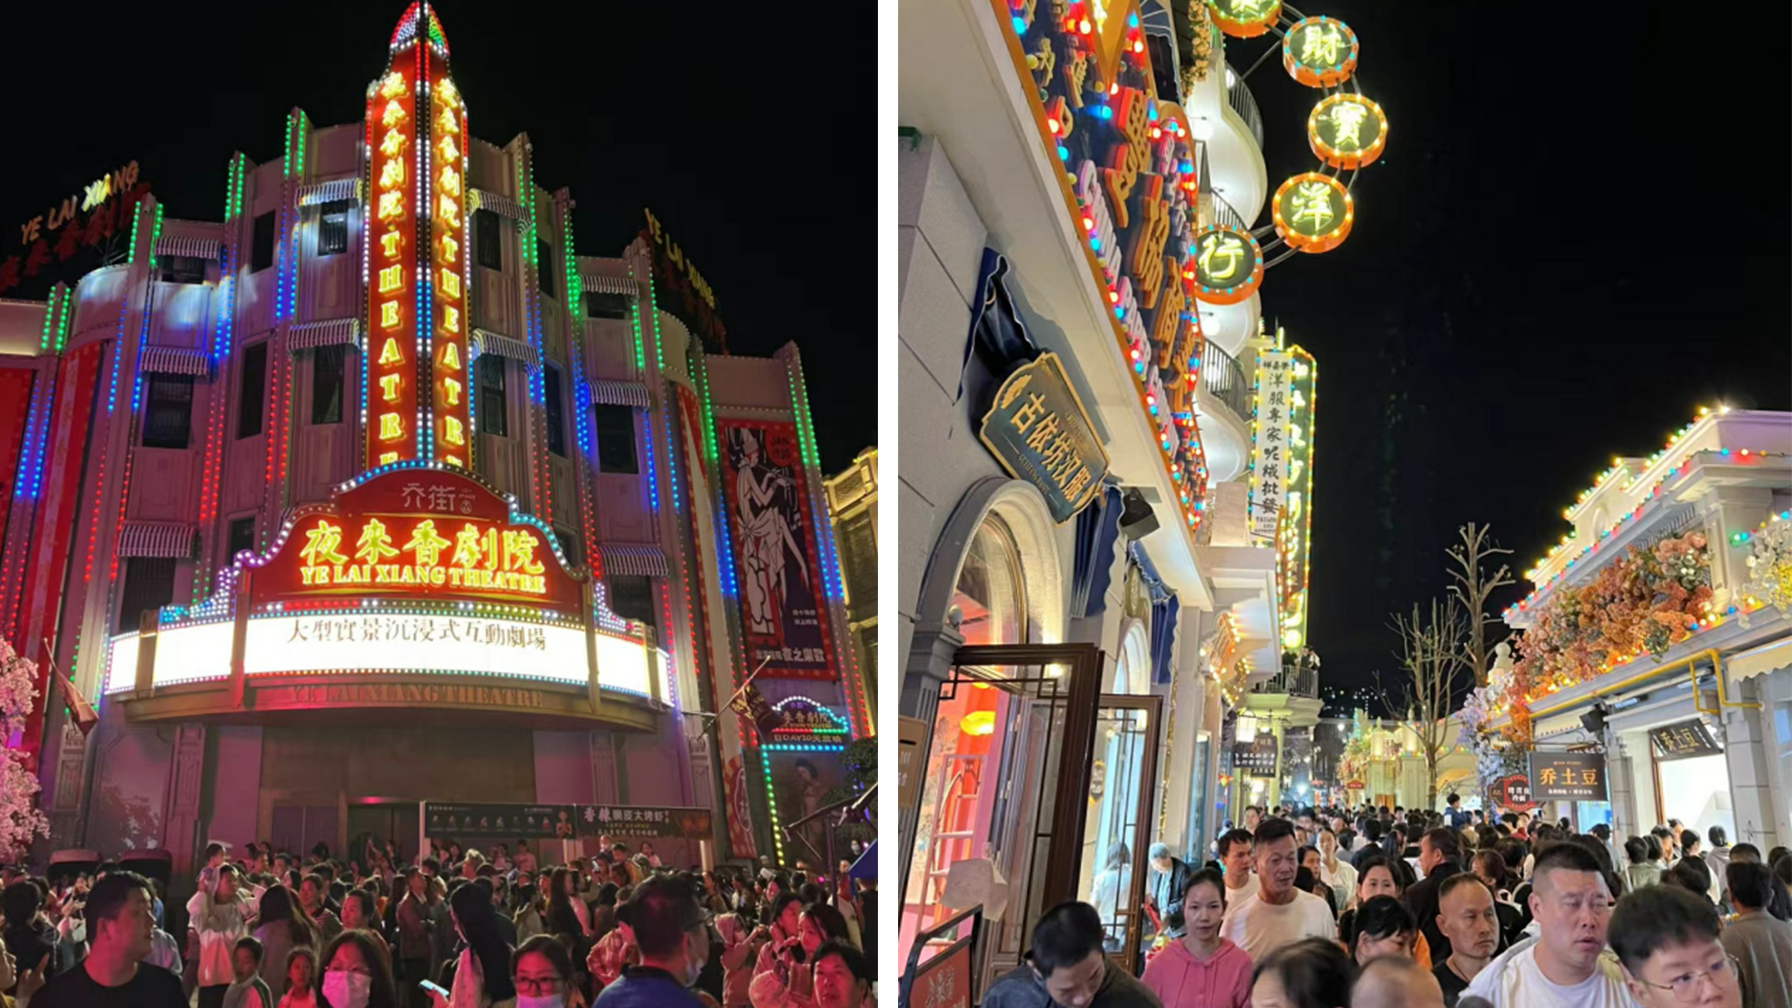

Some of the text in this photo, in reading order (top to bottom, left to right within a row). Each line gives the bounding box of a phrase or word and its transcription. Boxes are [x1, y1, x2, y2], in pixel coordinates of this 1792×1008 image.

[21, 215, 43, 245] YE
[1010, 392, 1091, 503] 古依坊汉服
[299, 518, 546, 575] 夜來香劇院
[300, 565, 546, 594] YE LAI XIANG THEATRE
[286, 618, 547, 651] 大型實景沉浸式互動劇場
[291, 683, 544, 707] YE LAI XIANG THEATRE
[1660, 727, 1700, 750] 乔土豆
[1540, 767, 1598, 786] 乔土豆
